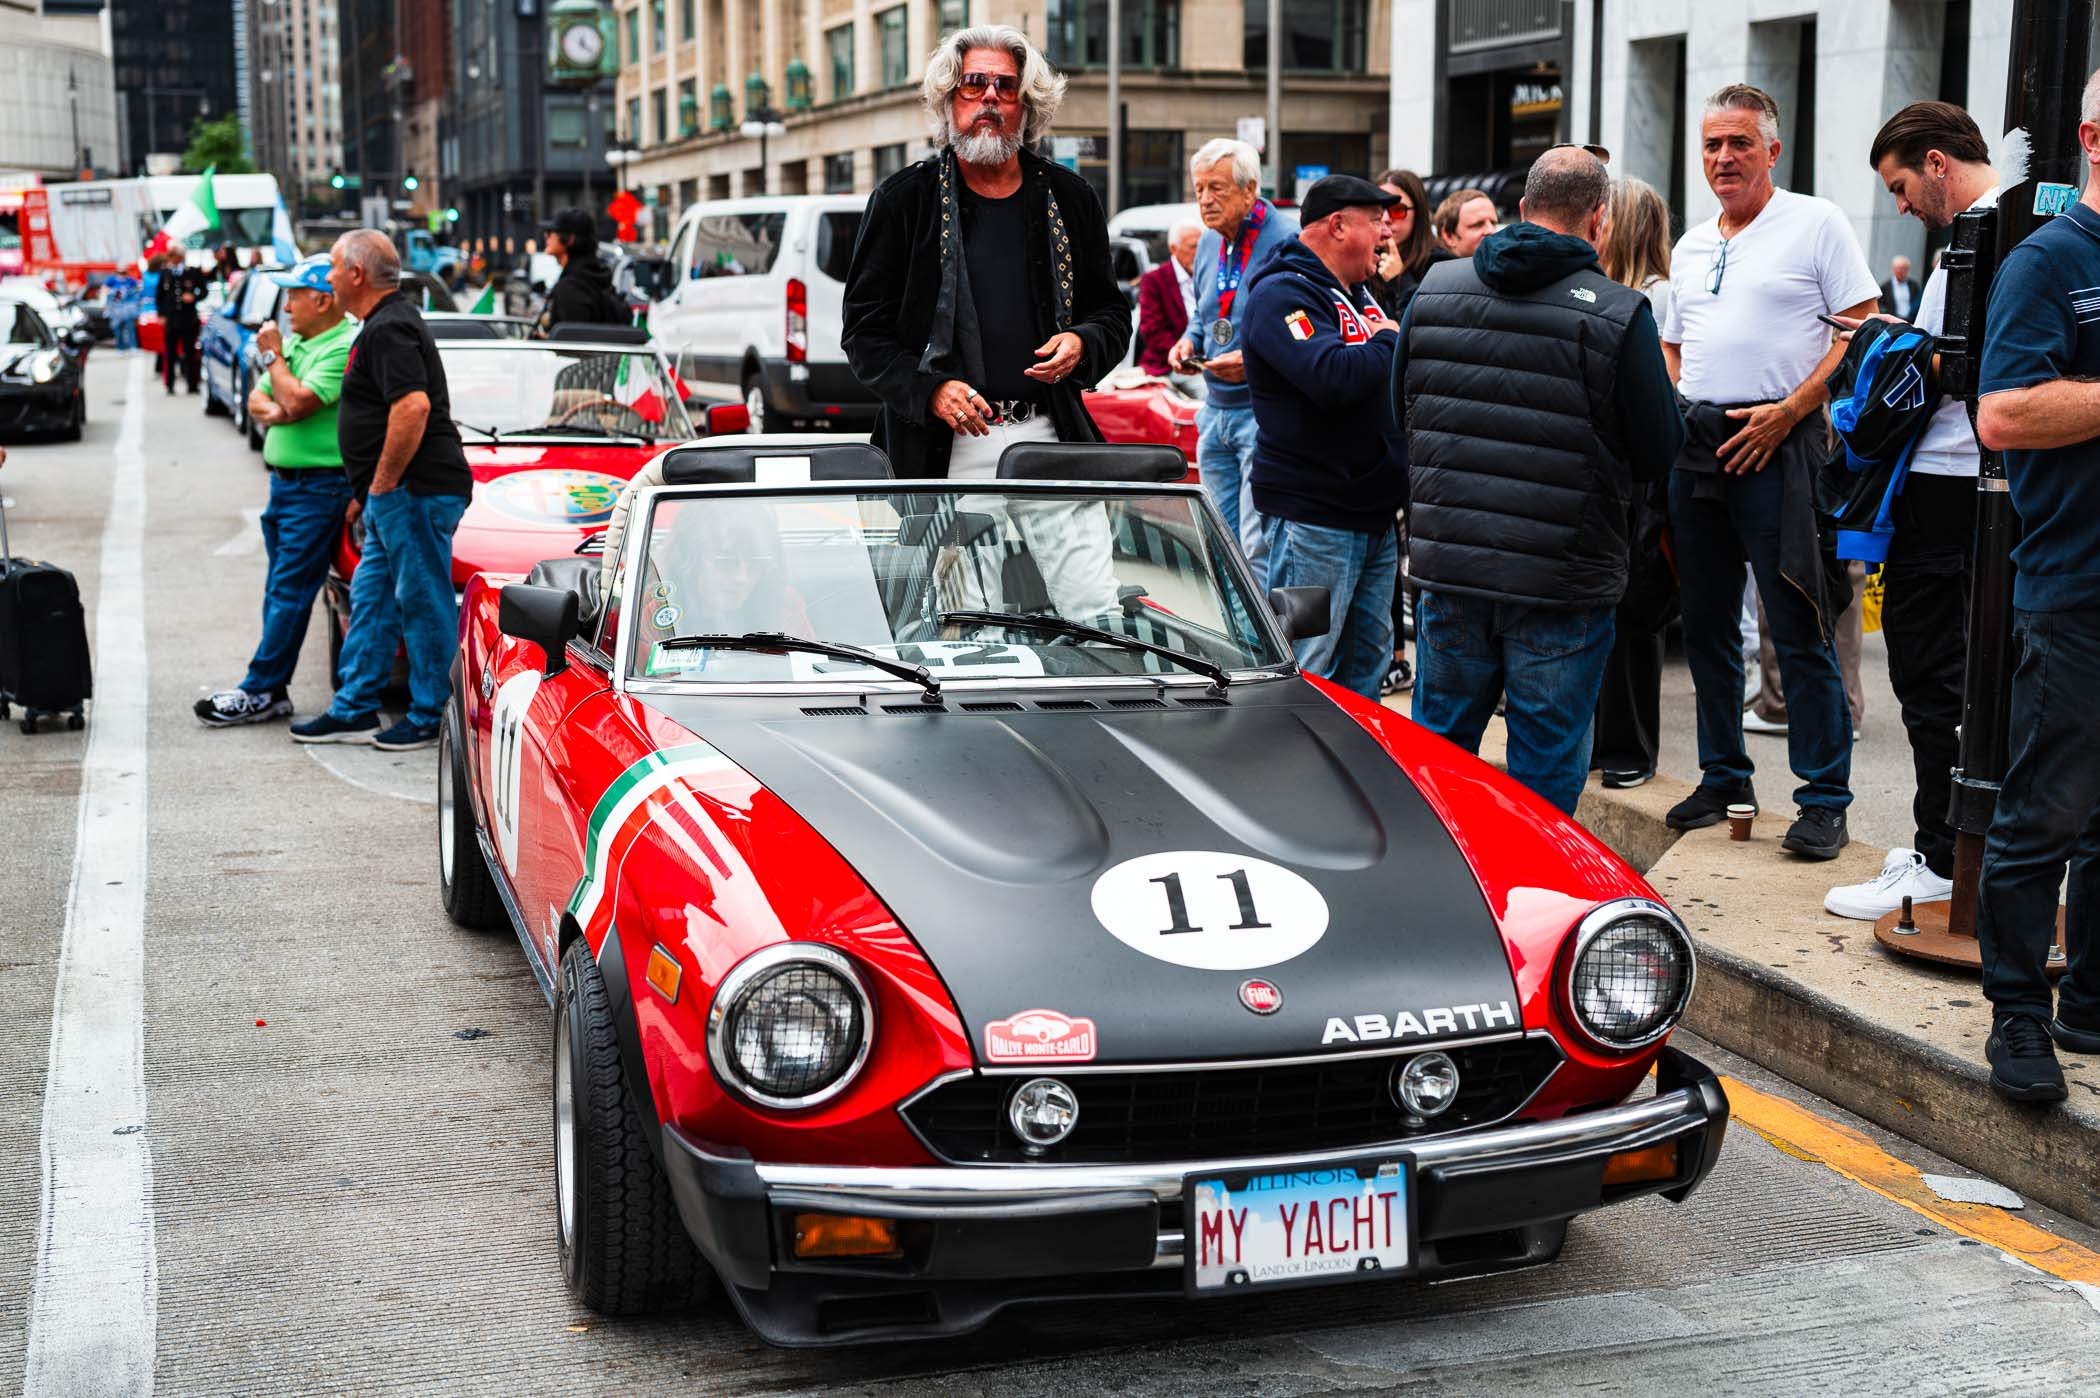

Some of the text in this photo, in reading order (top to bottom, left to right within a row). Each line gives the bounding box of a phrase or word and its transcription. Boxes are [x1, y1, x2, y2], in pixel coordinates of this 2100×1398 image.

[497, 703, 517, 834] 11
[1149, 869, 1272, 935] 11
[1245, 987, 1276, 1003] FIAT
[1321, 1001, 1516, 1044] ABARTH
[991, 1032, 1089, 1056] RALLYE MONTE-CARLO
[1246, 1168, 1357, 1191] ILLINOIS
[1202, 1192, 1398, 1266] MY YACHT
[1253, 1258, 1351, 1278] LAND OF LINCOLN
